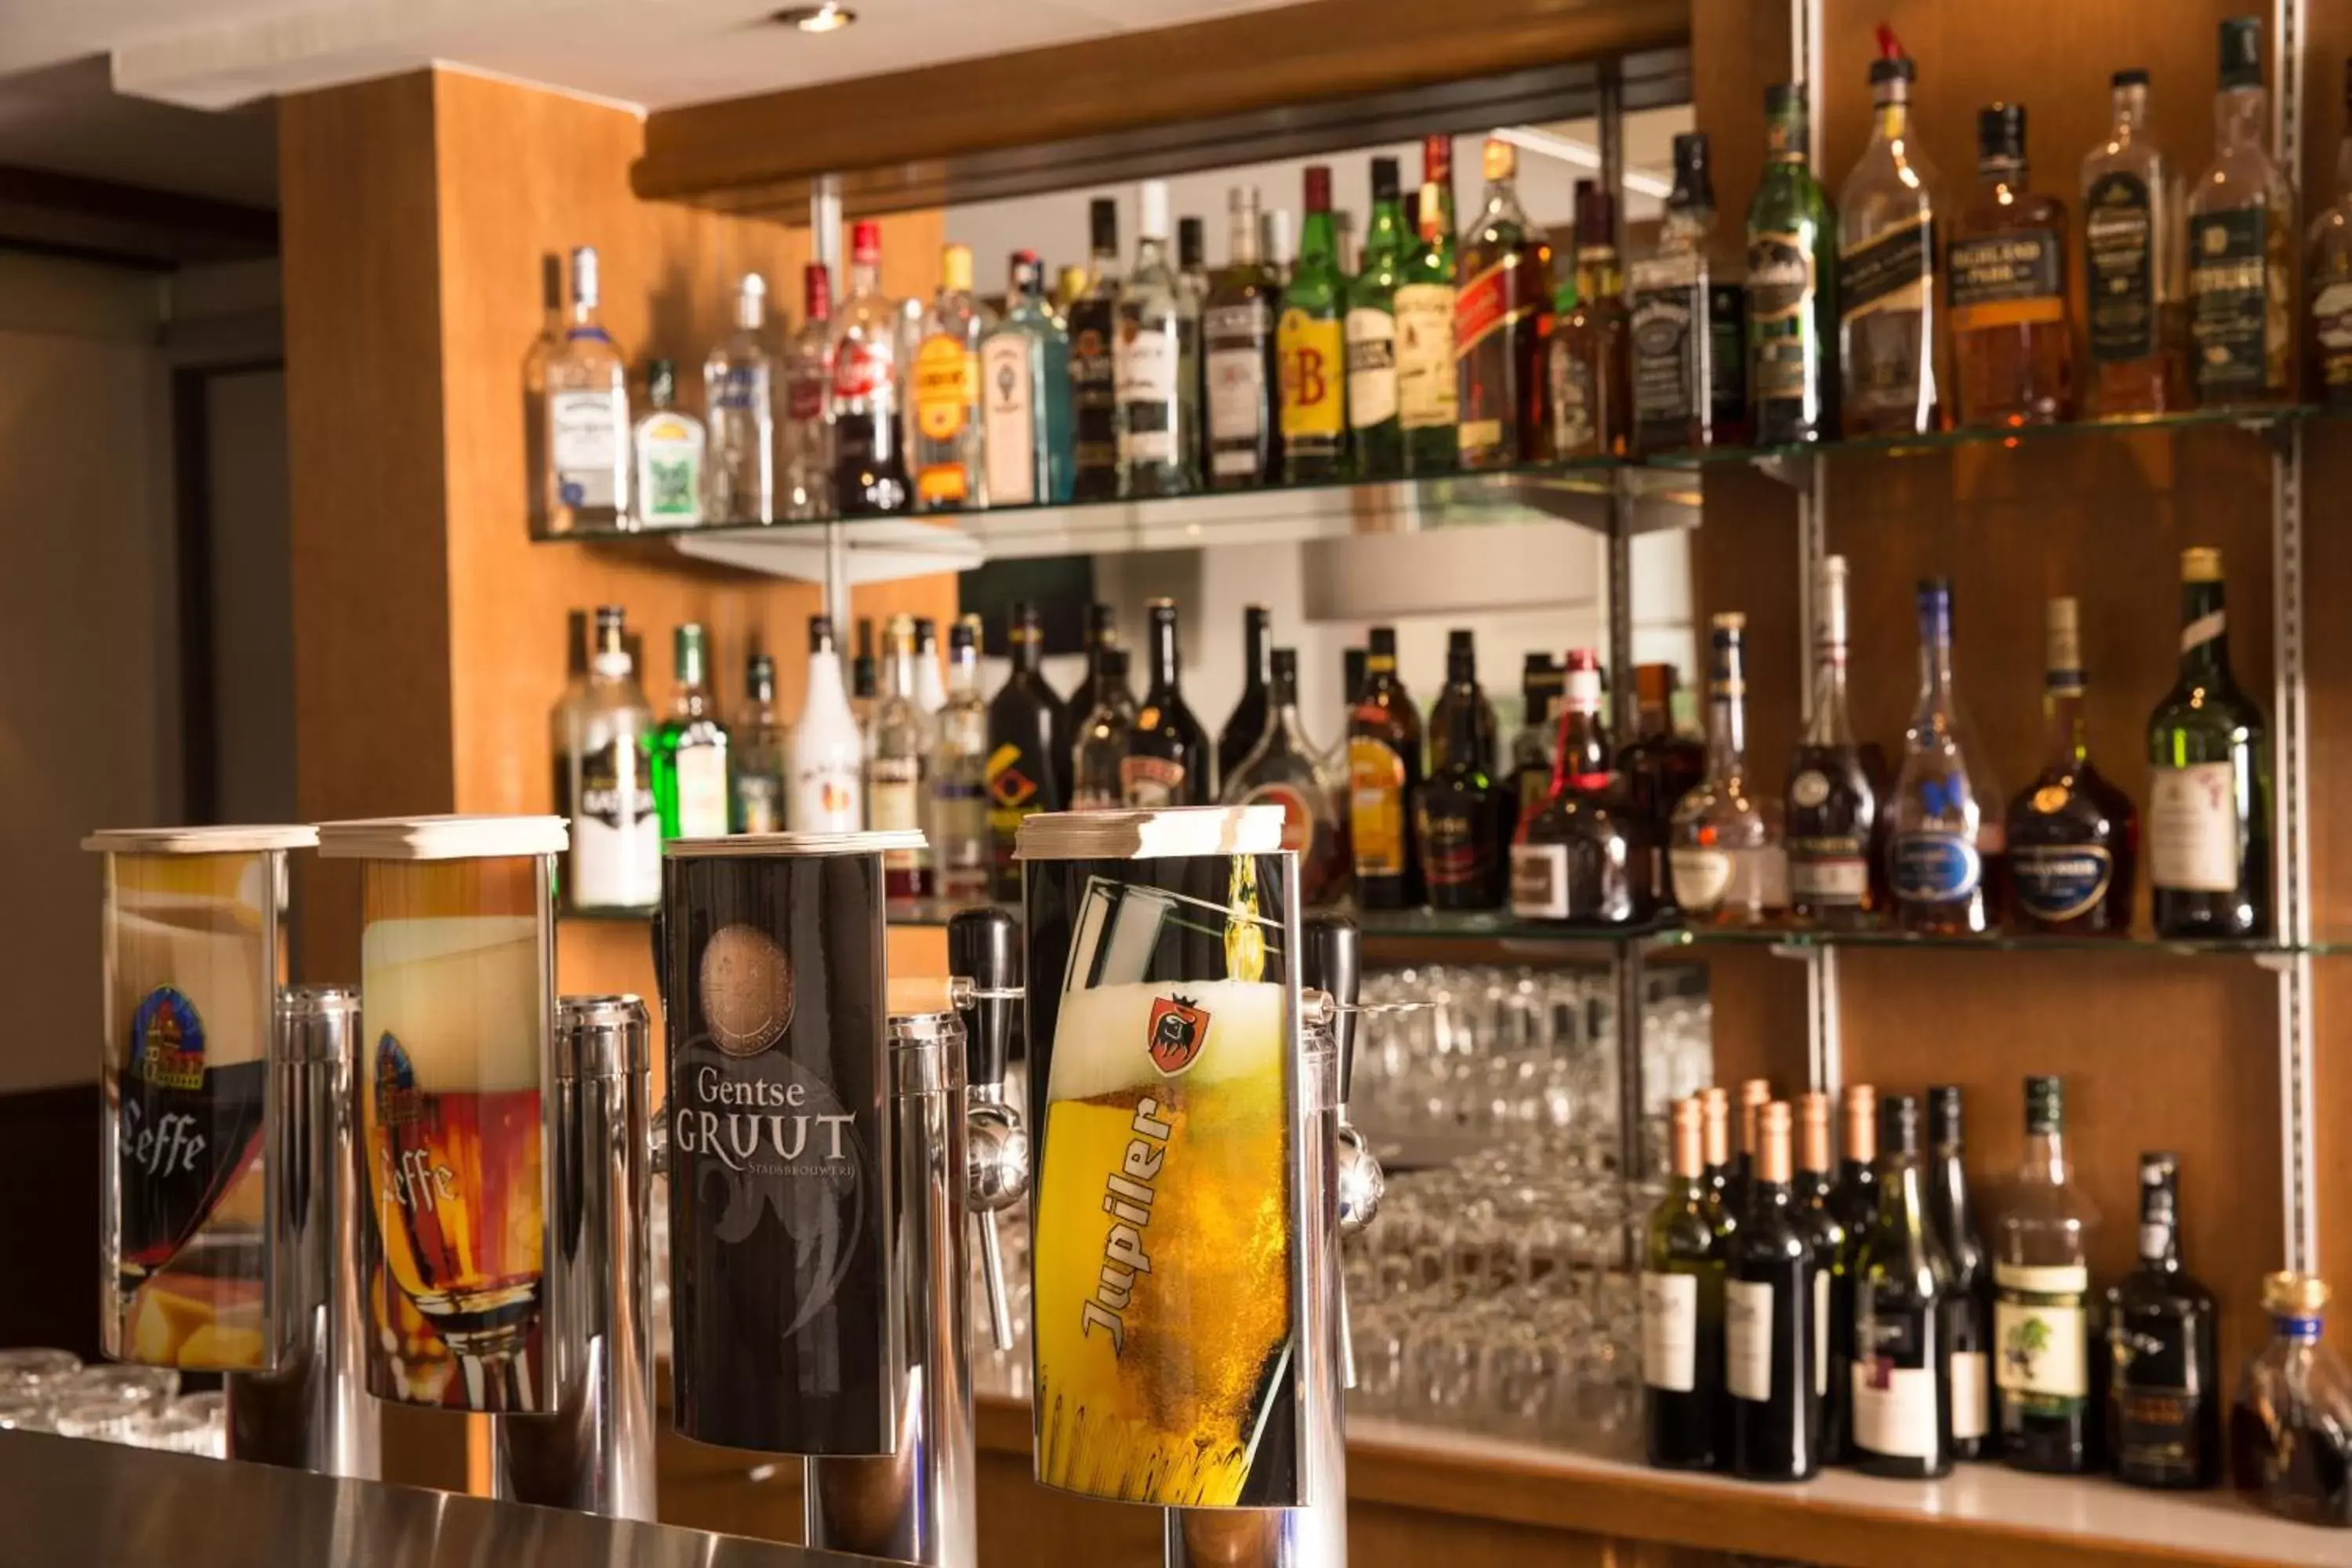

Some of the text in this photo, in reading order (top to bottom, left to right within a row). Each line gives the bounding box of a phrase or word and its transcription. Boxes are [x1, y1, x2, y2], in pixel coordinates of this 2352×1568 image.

[697, 1065, 806, 1107] Gentse
[118, 1098, 207, 1178] Leffe
[676, 1107, 858, 1171] GRUUT
[1081, 1096, 1171, 1362] Jupiler
